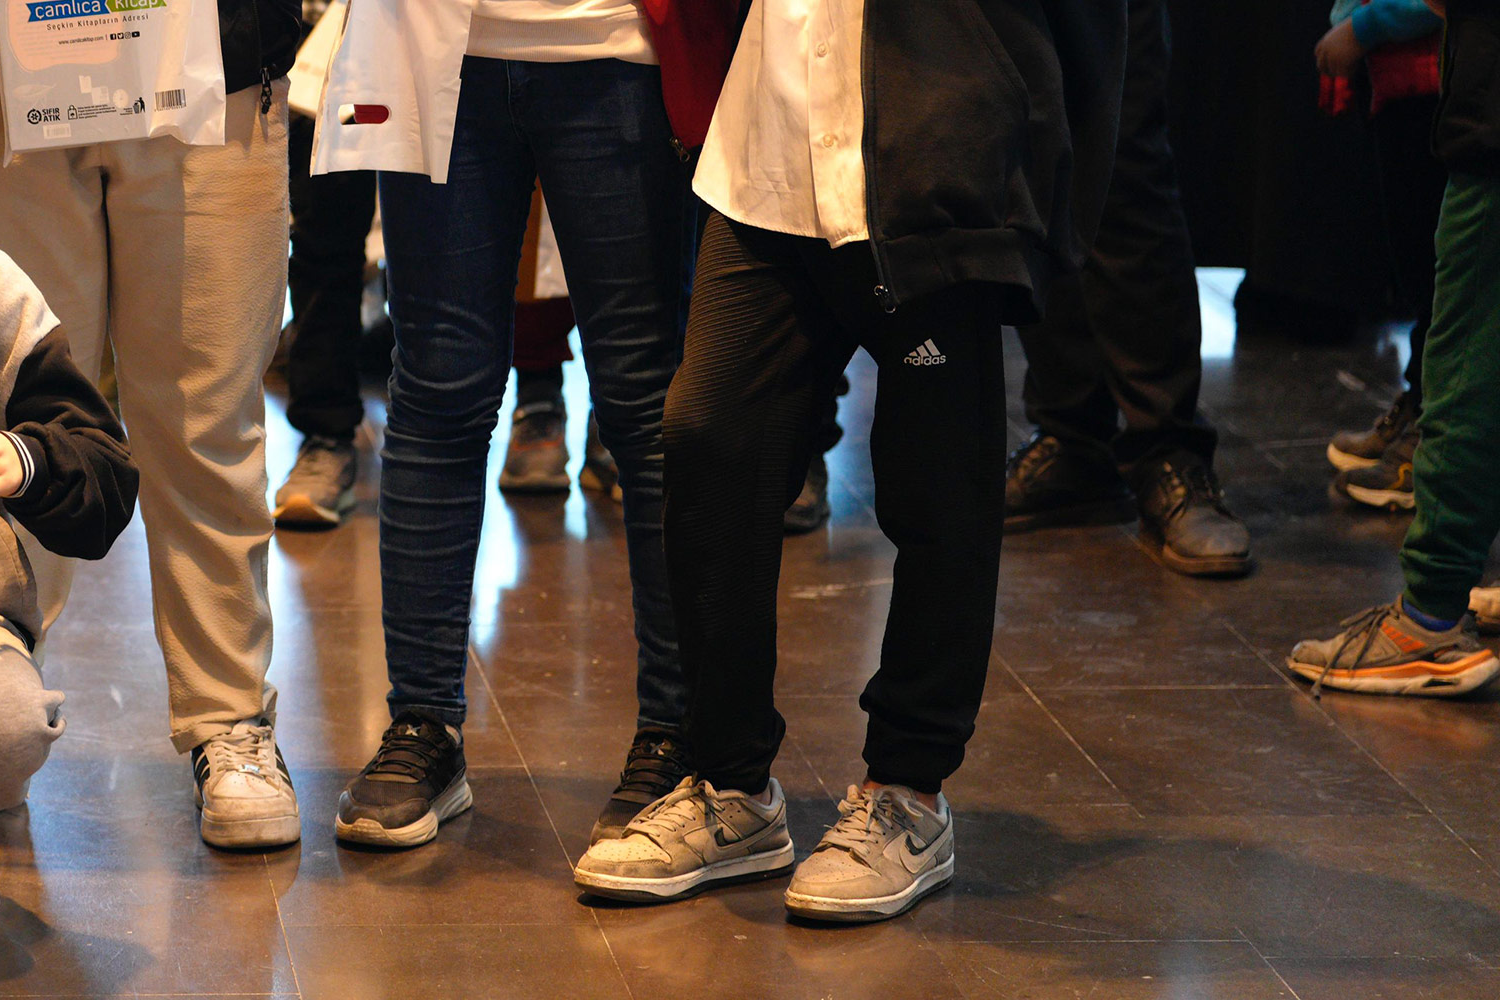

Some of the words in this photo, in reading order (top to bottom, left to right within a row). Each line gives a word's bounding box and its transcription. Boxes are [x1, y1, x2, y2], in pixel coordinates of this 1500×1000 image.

[46, 21, 74, 31] Seçkin
[77, 17, 119, 28] Kitapların
[122, 14, 149, 23] Adresi
[42, 107, 60, 115] SIFIR
[43, 114, 61, 122] ATIK
[903, 355, 947, 366] adidas
